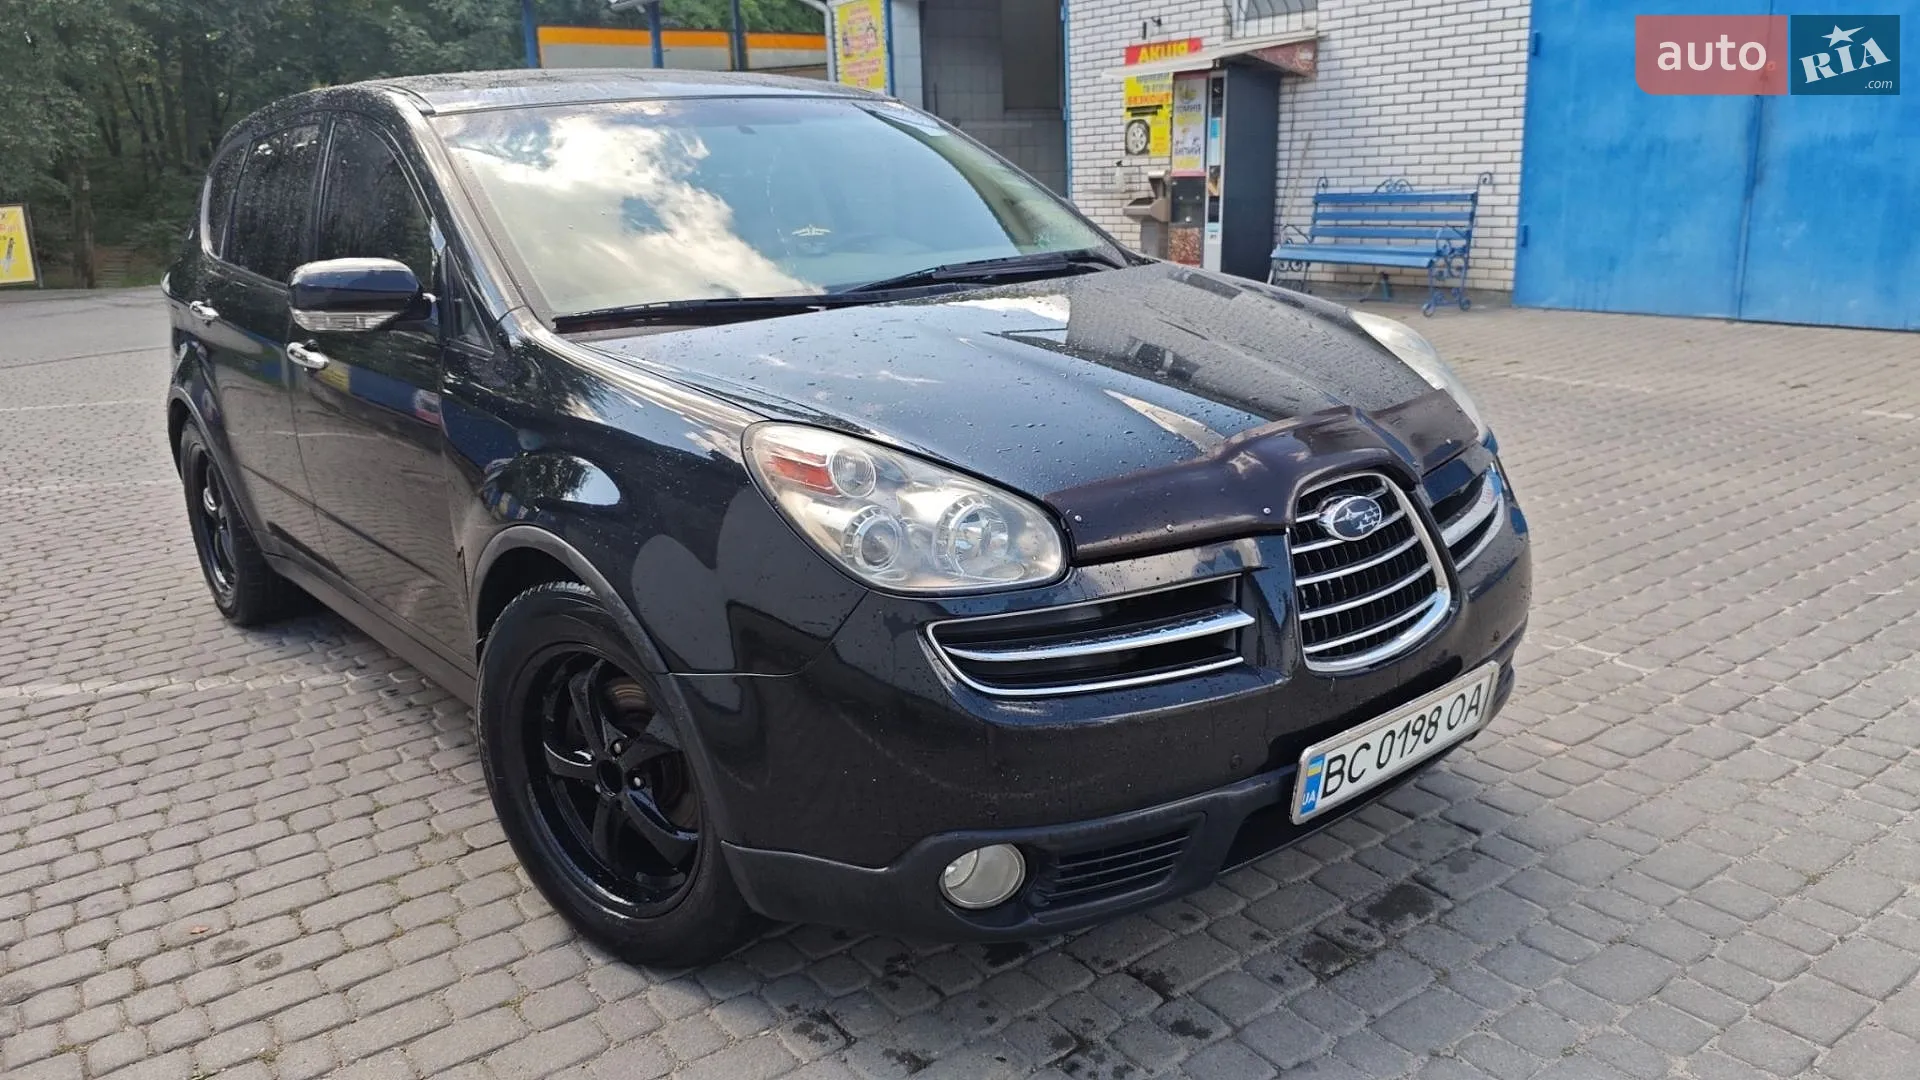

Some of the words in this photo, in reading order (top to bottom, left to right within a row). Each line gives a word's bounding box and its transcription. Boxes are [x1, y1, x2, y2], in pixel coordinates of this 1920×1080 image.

[1321, 742, 1371, 800] BC
[1376, 705, 1443, 770] 0198
[1446, 683, 1483, 731] OA
[1302, 789, 1317, 806] UA
